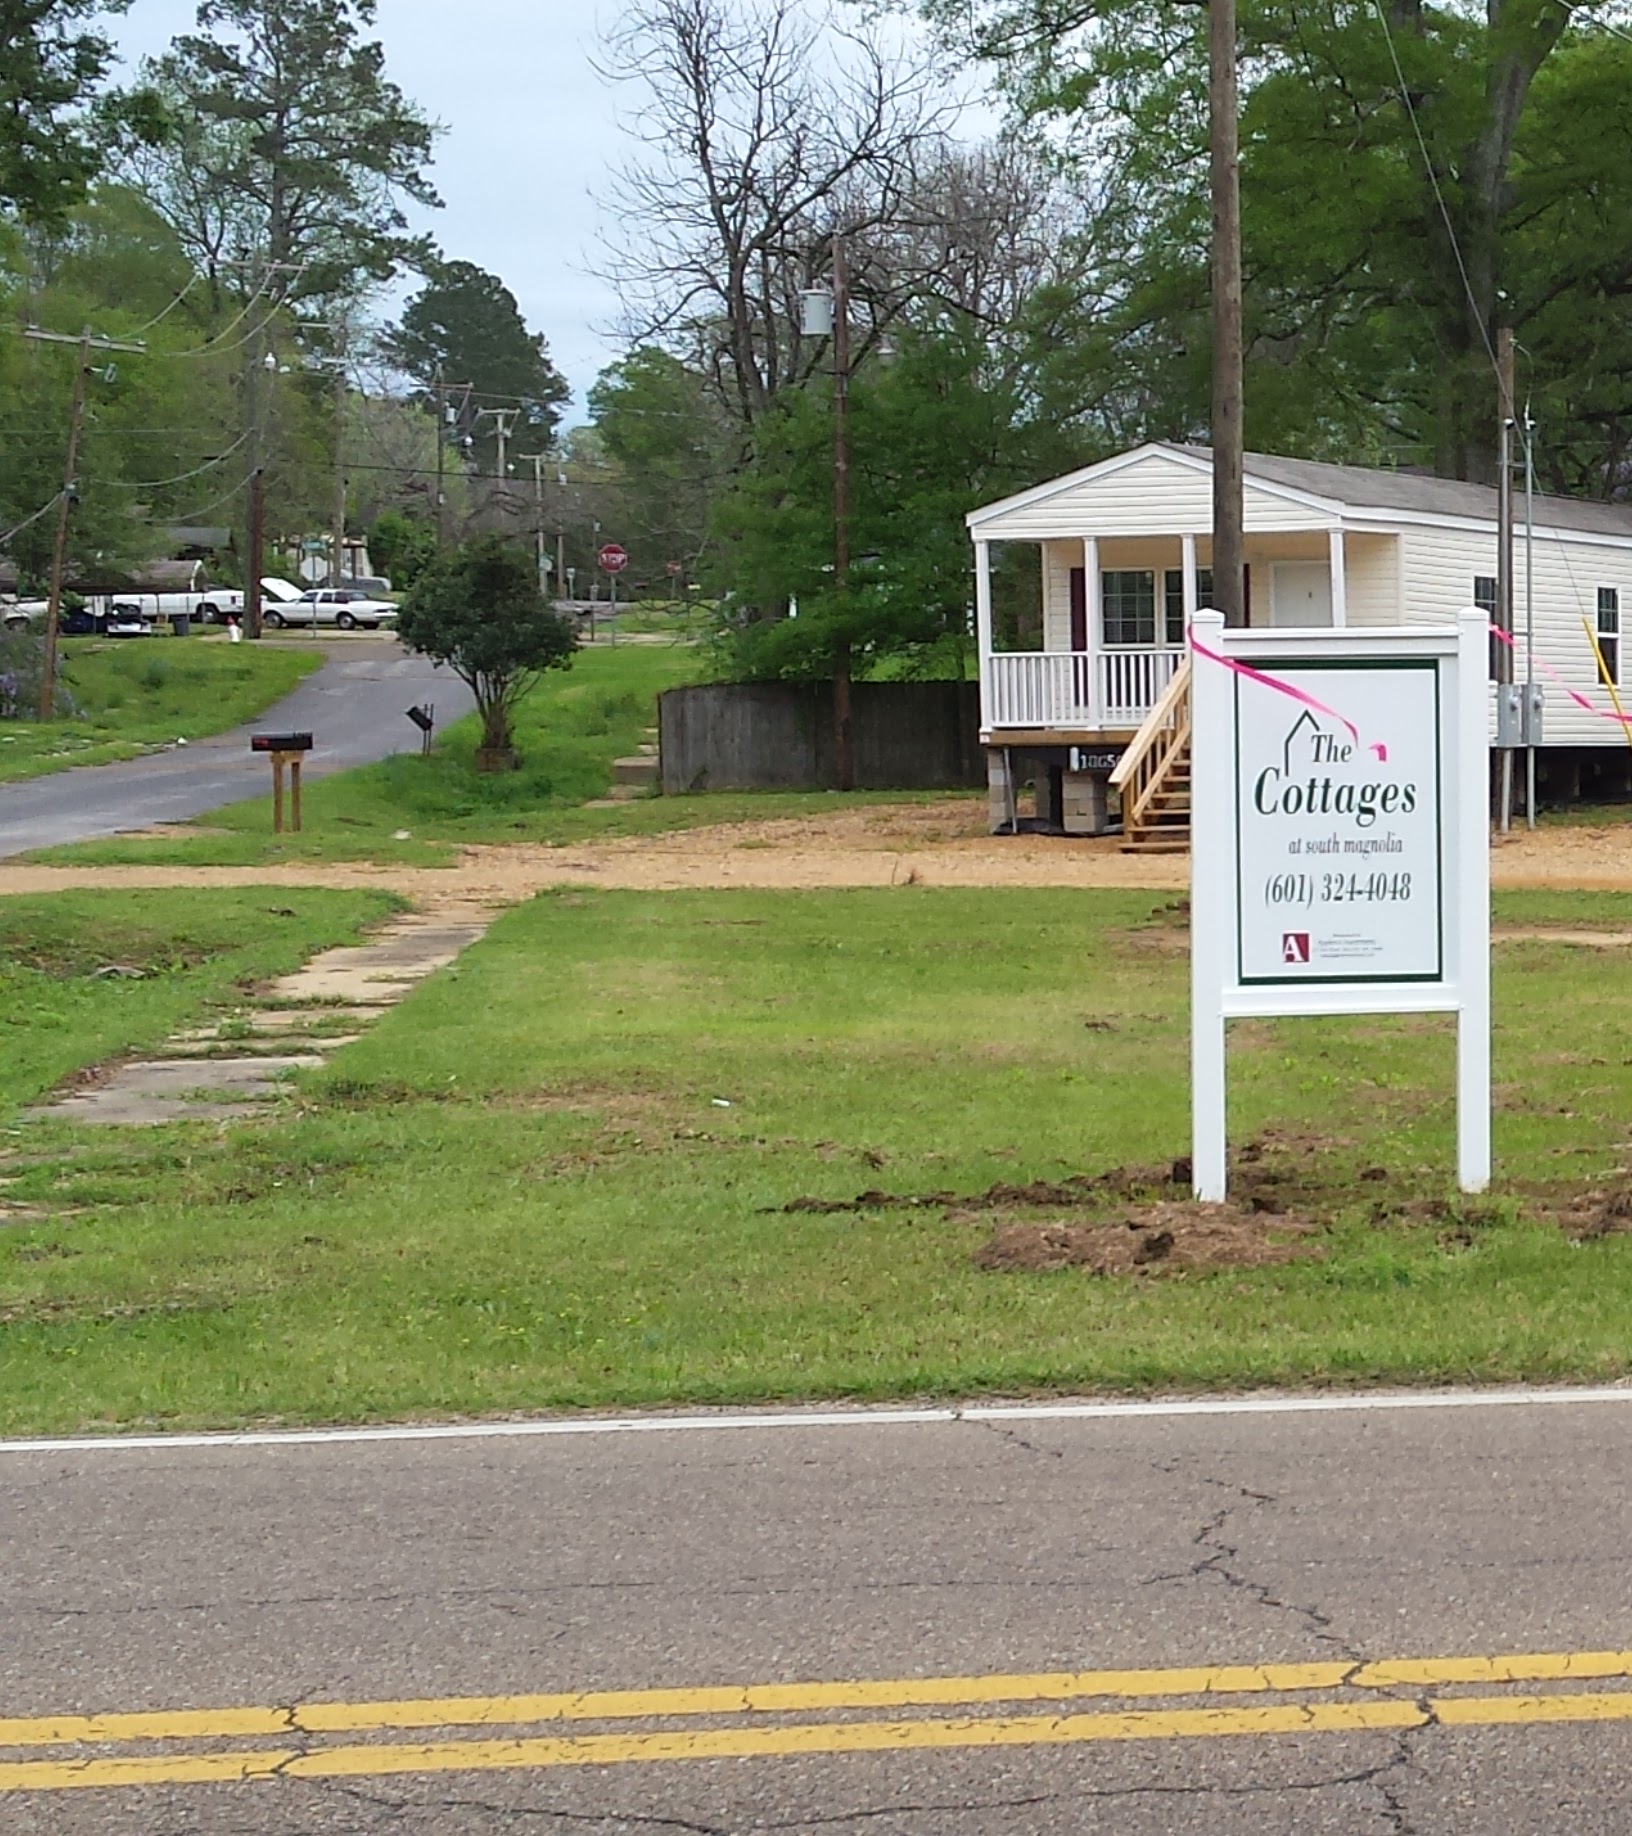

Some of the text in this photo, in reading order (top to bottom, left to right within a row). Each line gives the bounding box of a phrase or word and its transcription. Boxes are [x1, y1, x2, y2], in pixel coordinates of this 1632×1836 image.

[1311, 734, 1352, 763] The
[1254, 766, 1416, 828] Cottages
[1288, 831, 1403, 860] at south magnolia
[1265, 872, 1411, 910] (601) 324-4048
